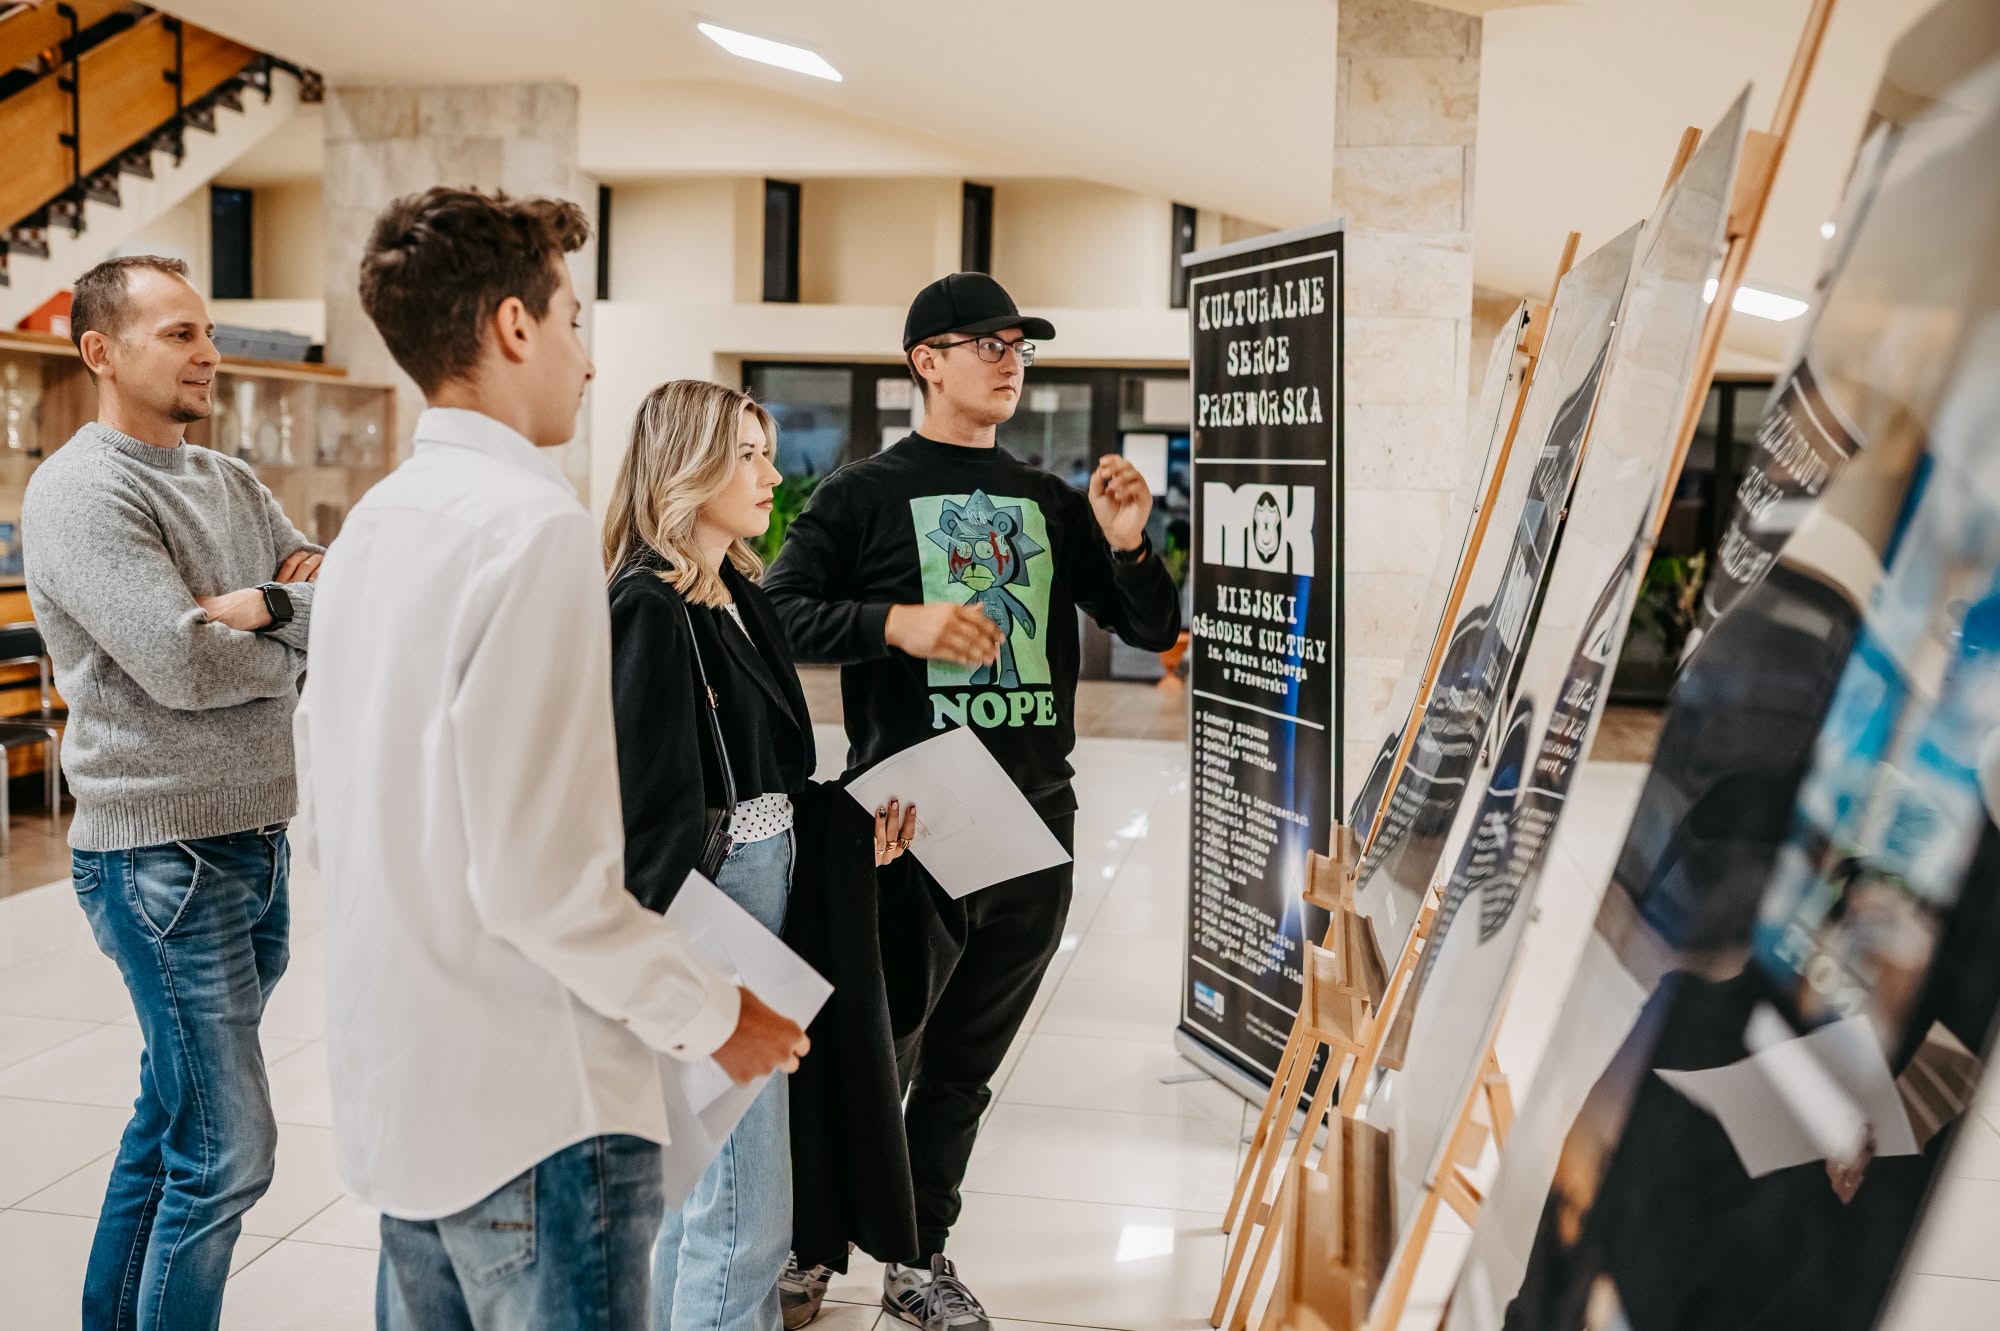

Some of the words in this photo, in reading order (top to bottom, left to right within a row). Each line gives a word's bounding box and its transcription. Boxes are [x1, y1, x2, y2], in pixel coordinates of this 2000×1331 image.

[1198, 276, 1325, 331] KULTURALNE
[1226, 336, 1290, 377] SERCE
[1198, 386, 1323, 427] PRZEWORSKA
[1216, 584, 1298, 624] MIEJSKI
[1192, 613, 1253, 647] OŚRODEK
[1258, 627, 1326, 664] KULTURY
[929, 691, 1057, 729] NOPE
